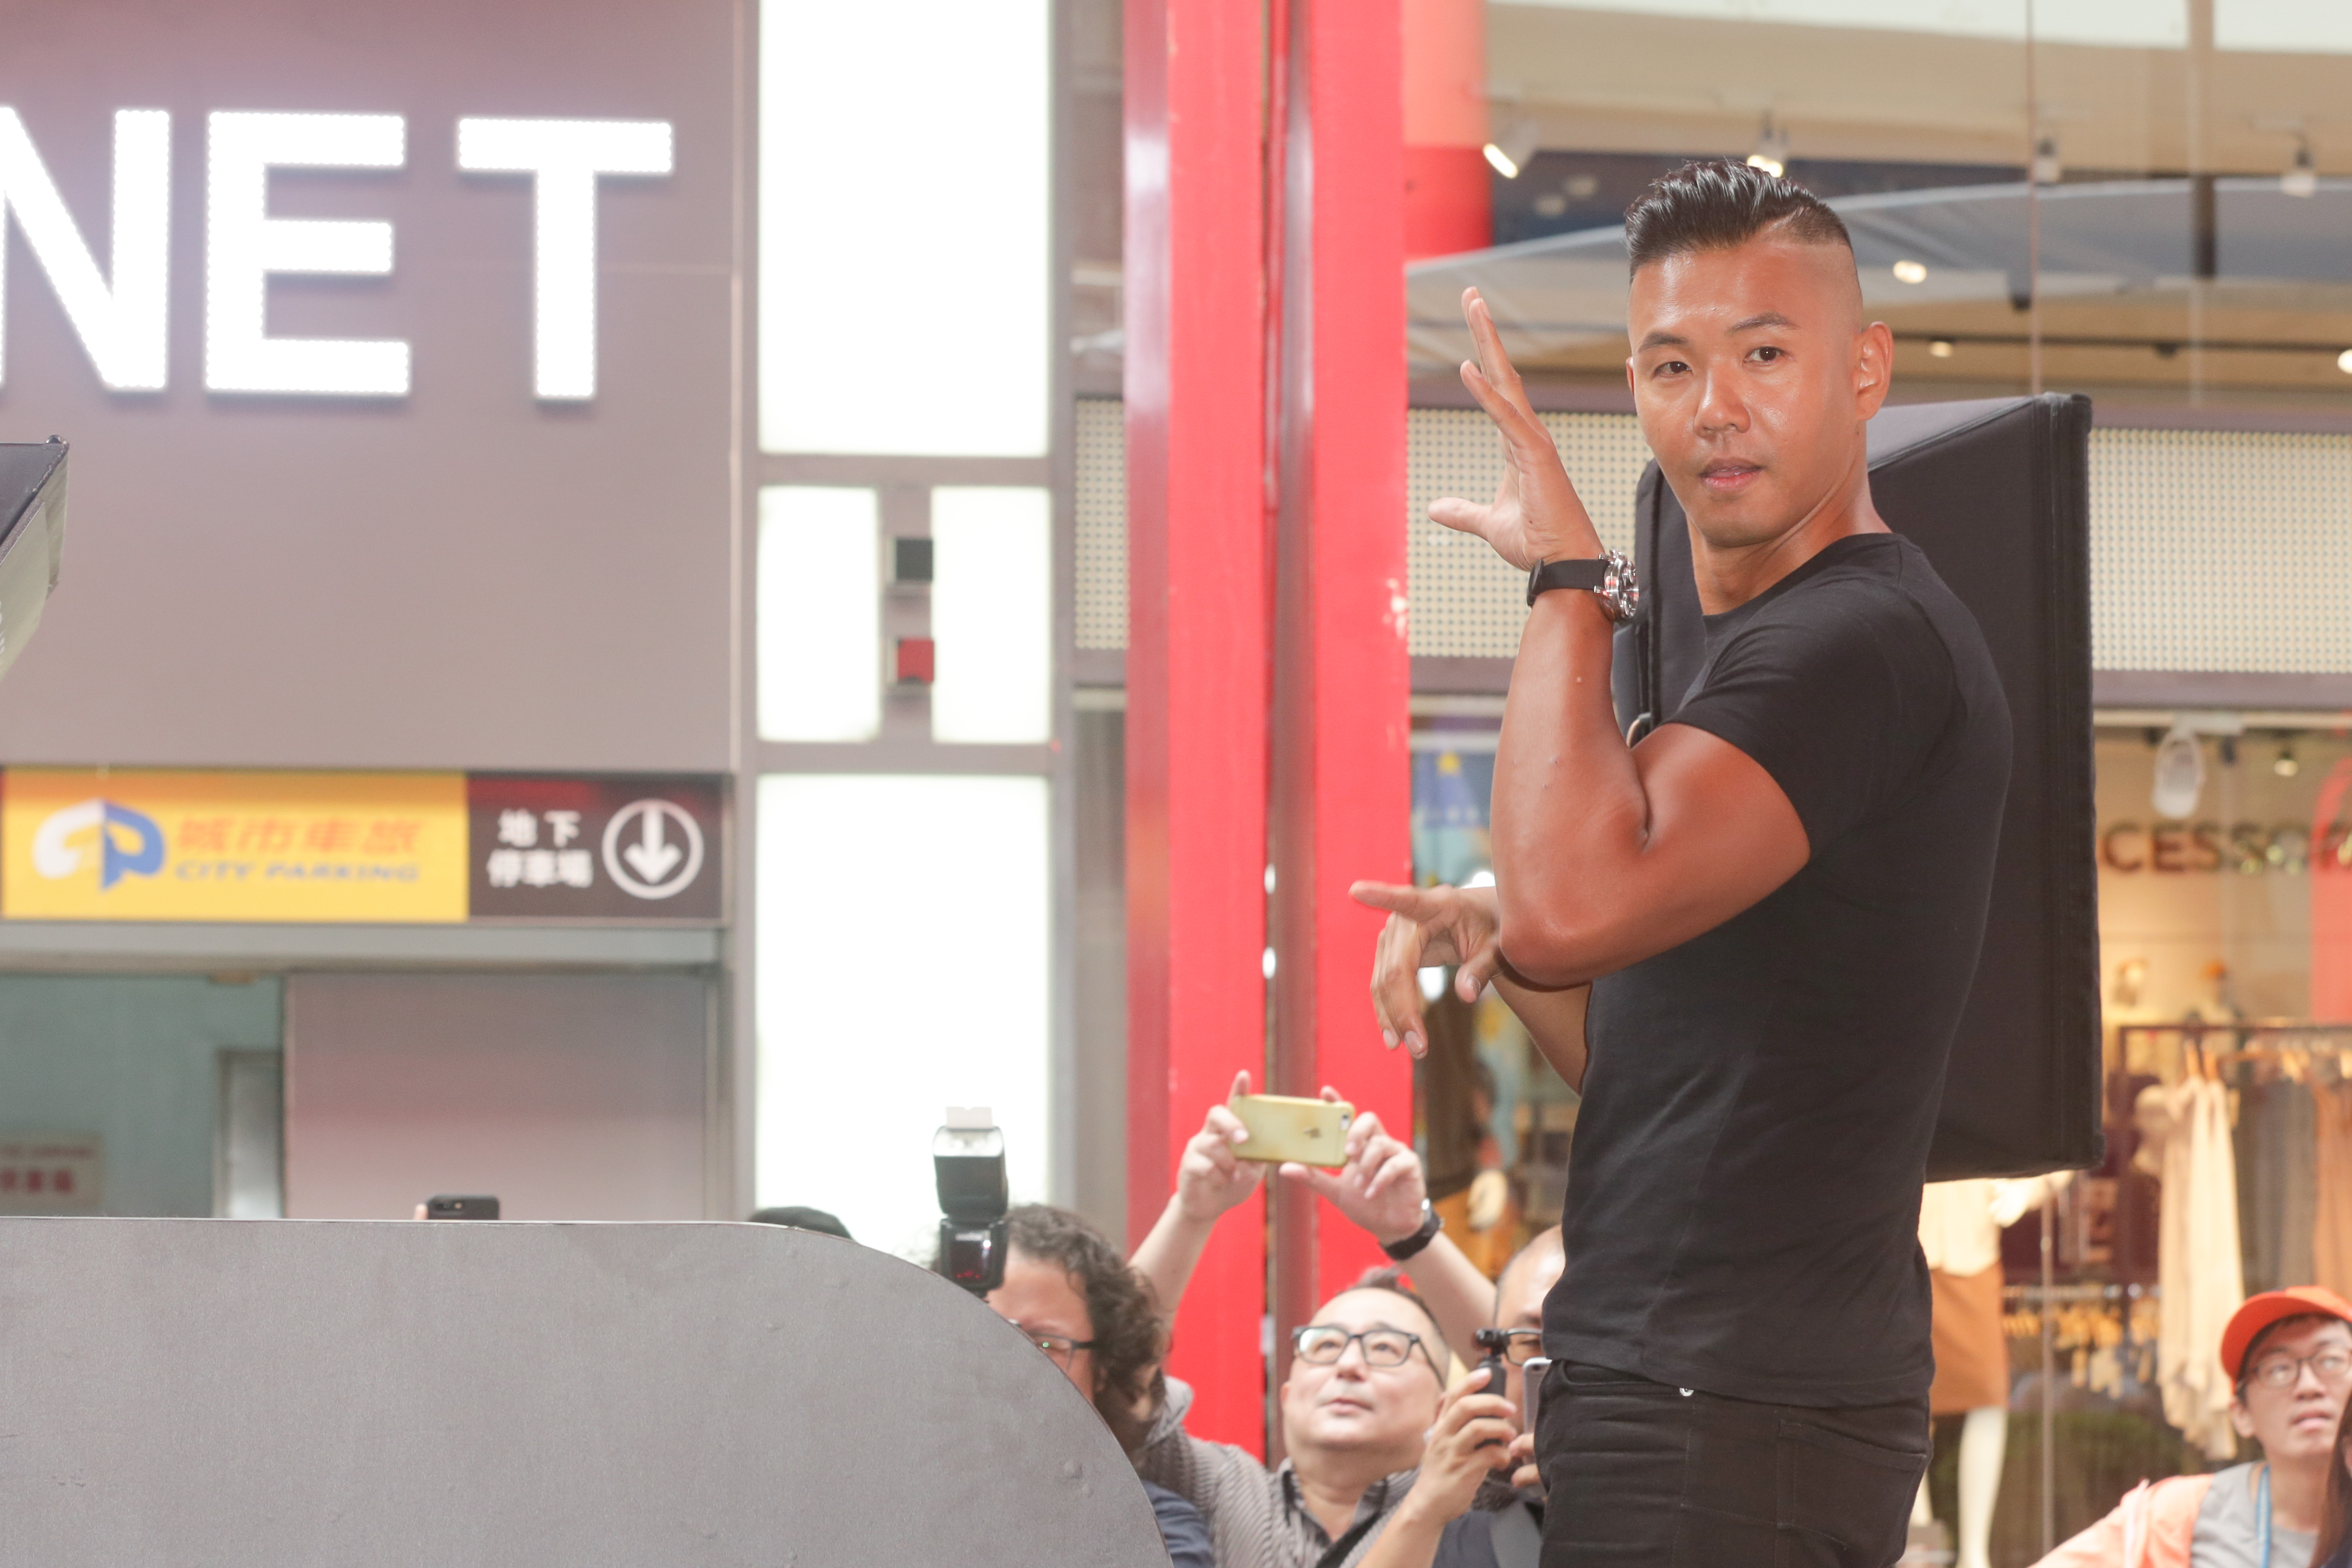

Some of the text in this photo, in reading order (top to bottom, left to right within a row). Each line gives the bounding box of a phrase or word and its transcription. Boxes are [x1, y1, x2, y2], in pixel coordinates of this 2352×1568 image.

[0, 106, 672, 398] NET
[498, 808, 582, 847] 地下
[174, 860, 421, 883] CITY PARKING
[486, 849, 593, 888] 停車場
